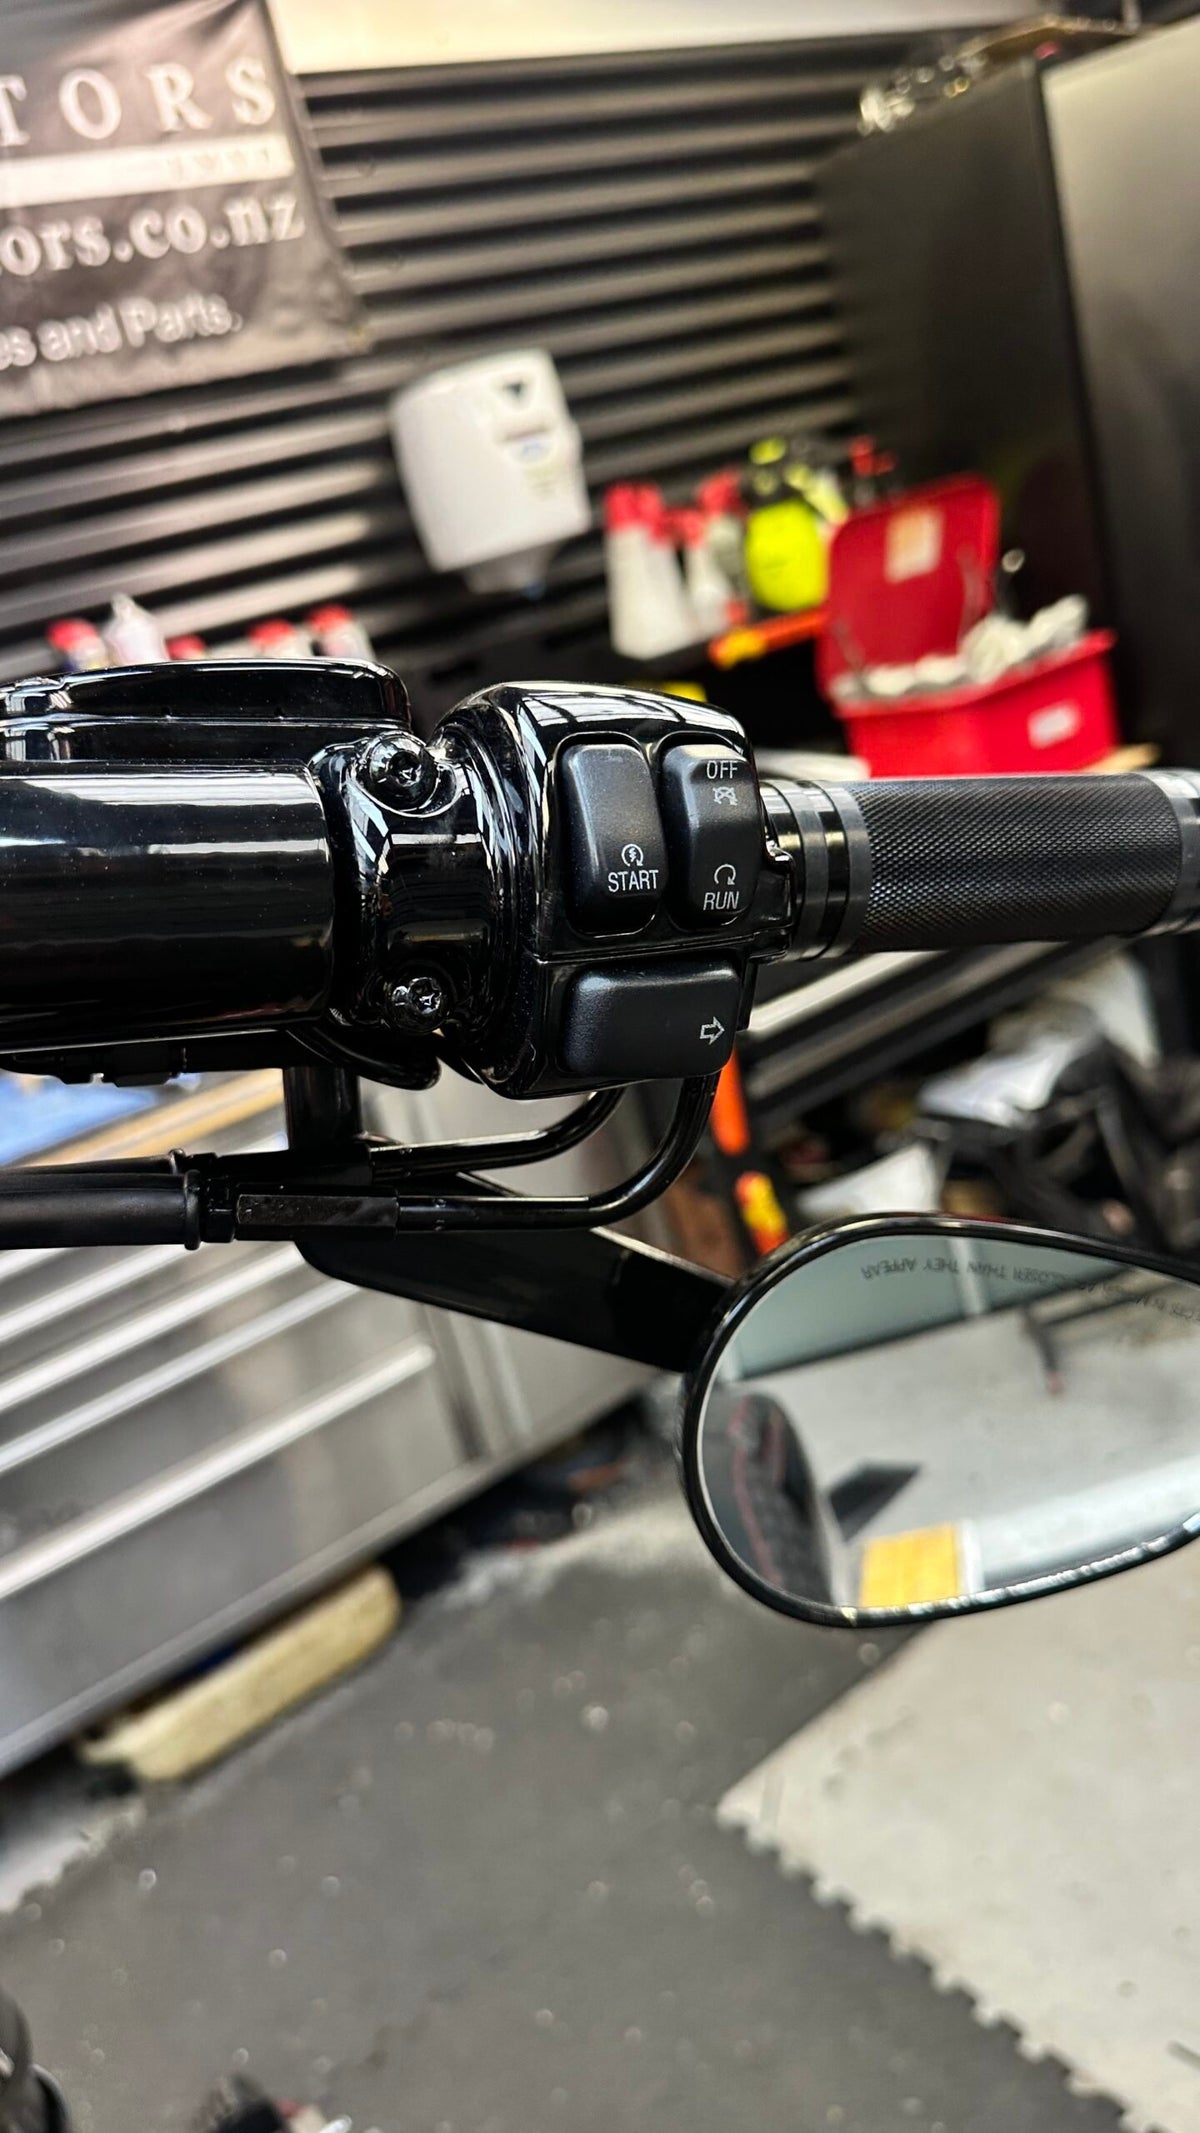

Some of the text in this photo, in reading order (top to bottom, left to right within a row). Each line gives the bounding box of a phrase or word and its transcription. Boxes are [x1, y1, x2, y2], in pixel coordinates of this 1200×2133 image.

[0, 194, 306, 276] ors.co.nz
[36, 302, 123, 362] and
[706, 761, 738, 780] OFF
[608, 869, 659, 893] START
[703, 891, 739, 911] RUN
[860, 1257, 917, 1280] APPEAR
[923, 1257, 959, 1274] THEY
[966, 1260, 1007, 1280] THAN
